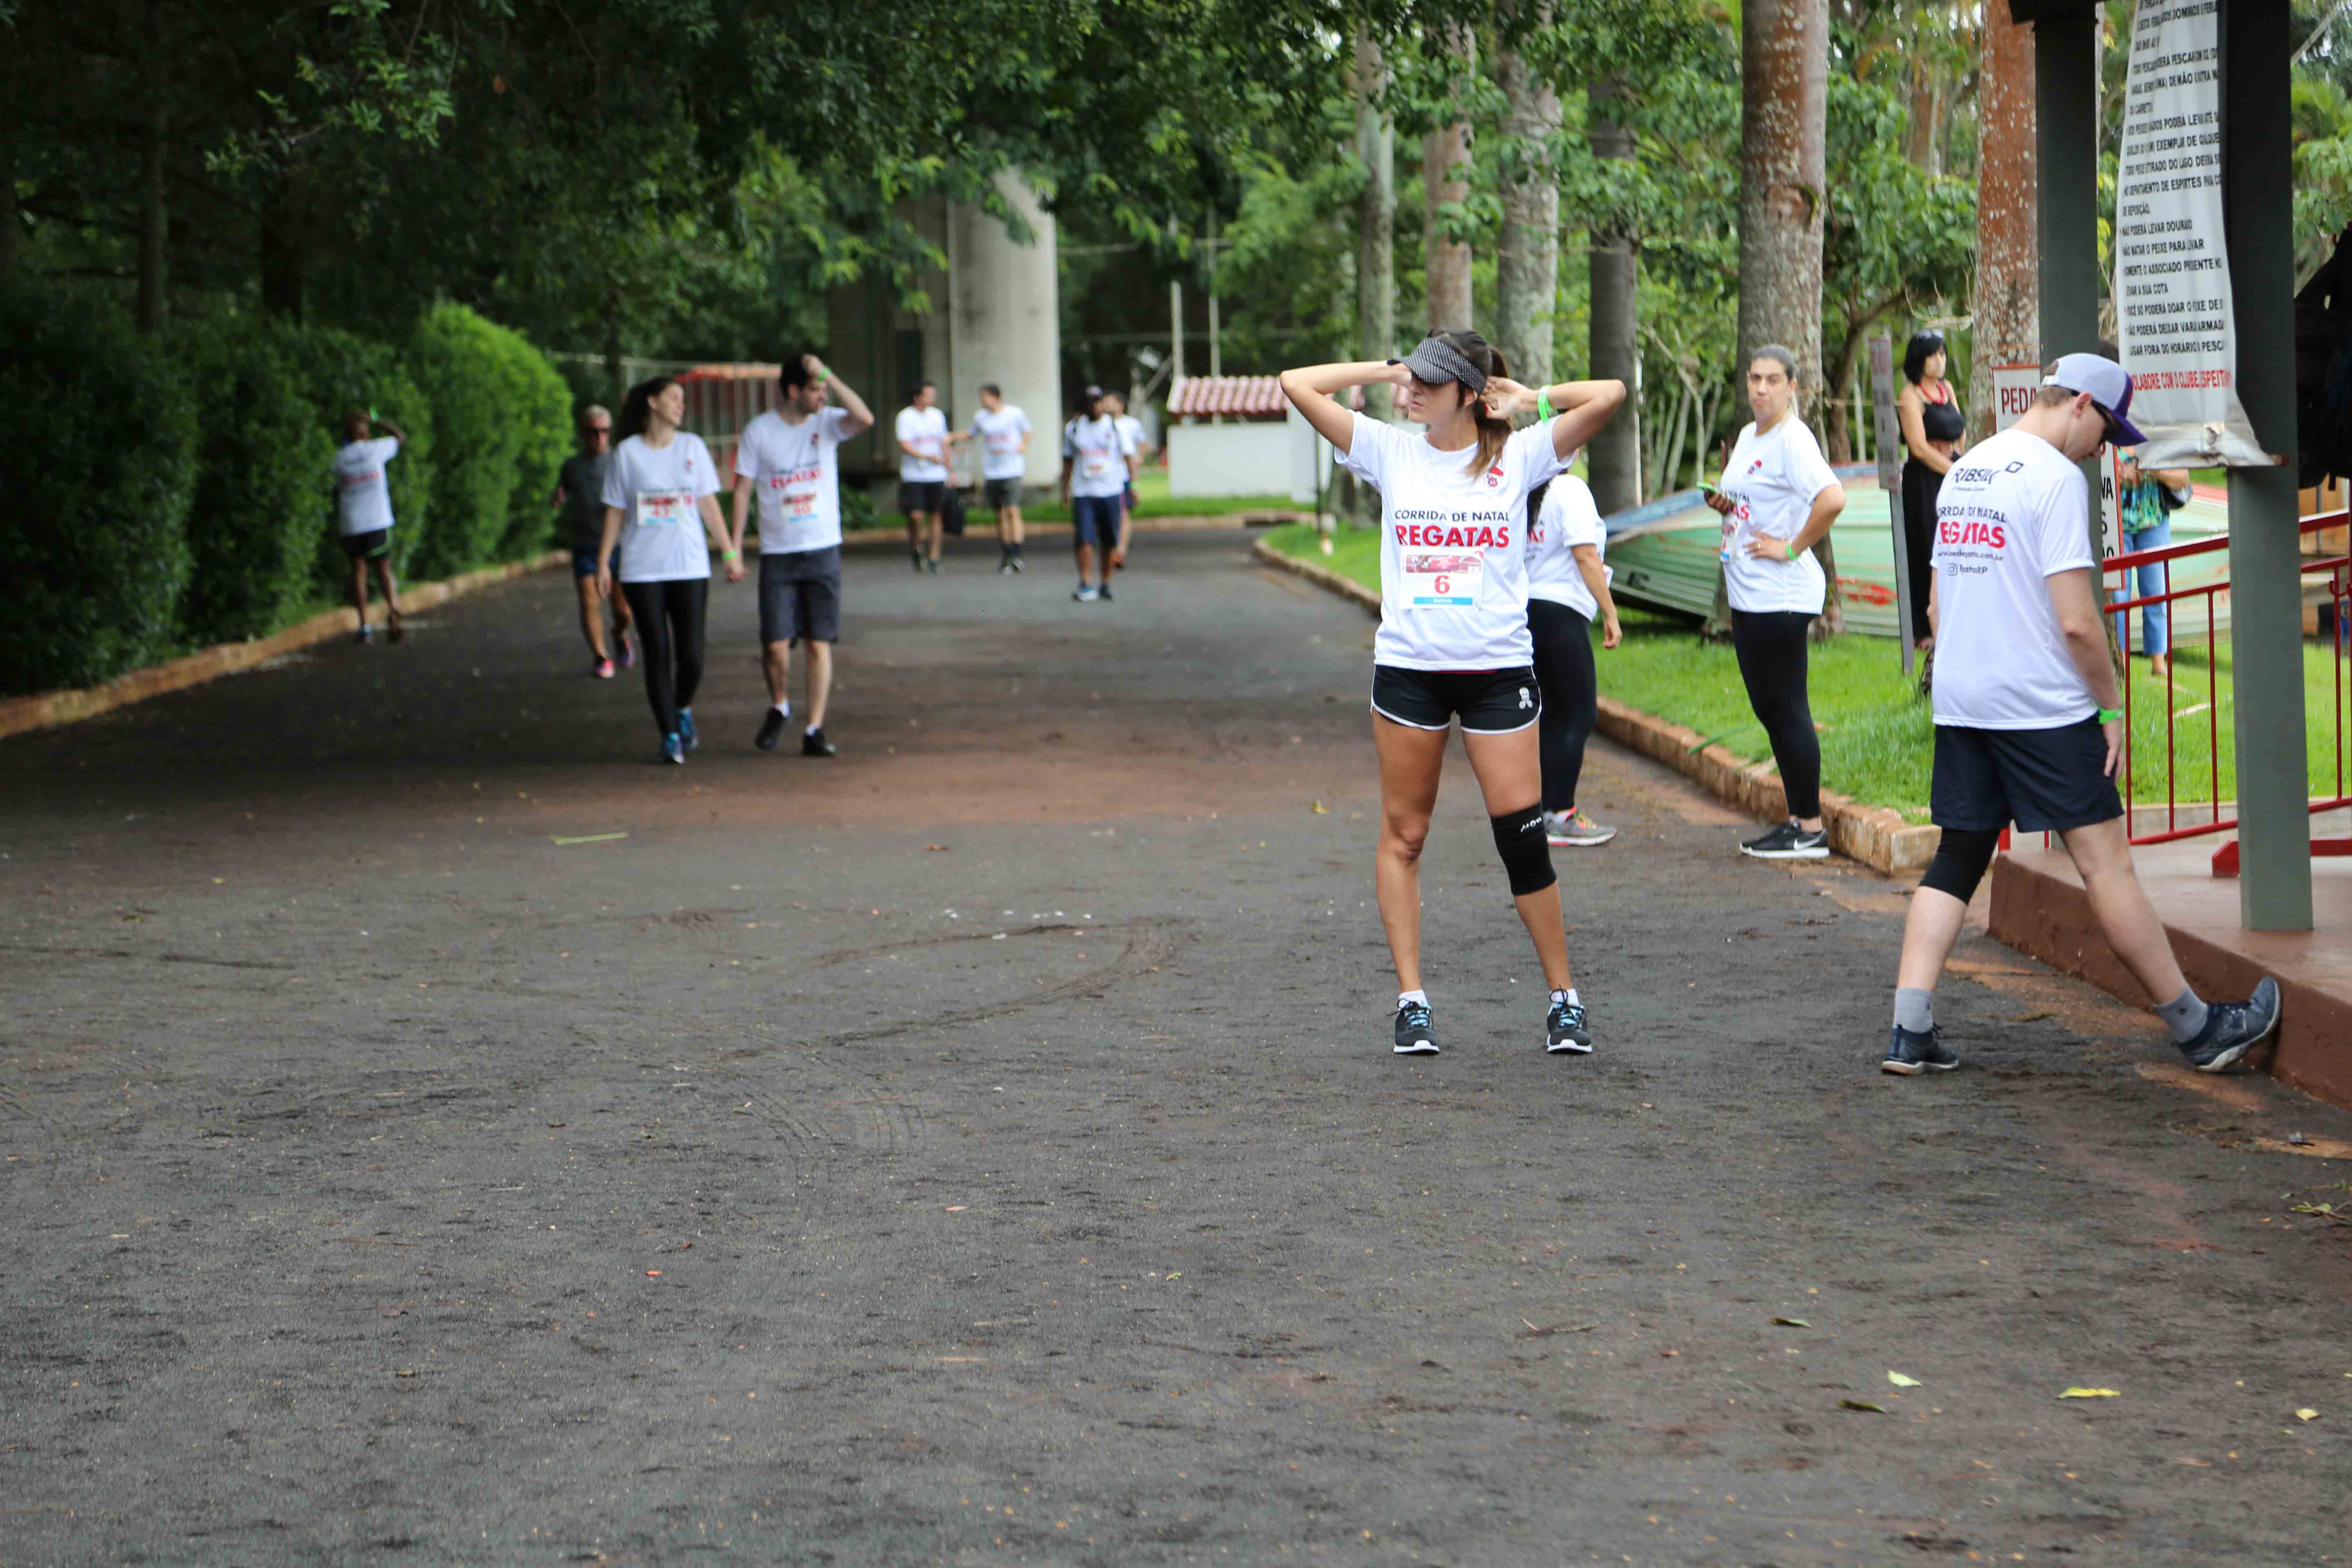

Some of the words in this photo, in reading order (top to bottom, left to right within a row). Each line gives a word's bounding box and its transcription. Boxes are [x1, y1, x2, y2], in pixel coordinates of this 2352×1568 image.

[2187, 136, 2197, 147] DE
[2168, 158, 2178, 170] DO
[2161, 180, 2169, 192] DE
[2147, 223, 2165, 234] LEVAR
[2146, 244, 2150, 254] O
[2152, 243, 2168, 254] PEIXE
[2169, 240, 2186, 253] PARA
[2149, 261, 2182, 275] ASSOCIADO
[2153, 283, 2169, 295] COTA
[2145, 301, 2167, 315] PODERÁ
[2167, 302, 2185, 314] DOAR
[2187, 302, 2192, 312] O
[2208, 299, 2219, 310] DE
[2136, 323, 2158, 335] PODERÁ
[2158, 323, 2179, 335] DEIXAR
[2144, 344, 2160, 355] FORA
[2161, 344, 2170, 354] DO
[2161, 372, 2174, 388] COM
[1394, 509, 1447, 521] CORRIDA
[1452, 512, 1468, 522] DE
[1472, 512, 1510, 522] NATAL
[1977, 507, 2007, 523] NATAL
[1395, 524, 1510, 548] REGATAS
[1938, 521, 2006, 549] EGATAS
[1434, 575, 1450, 594] 6
